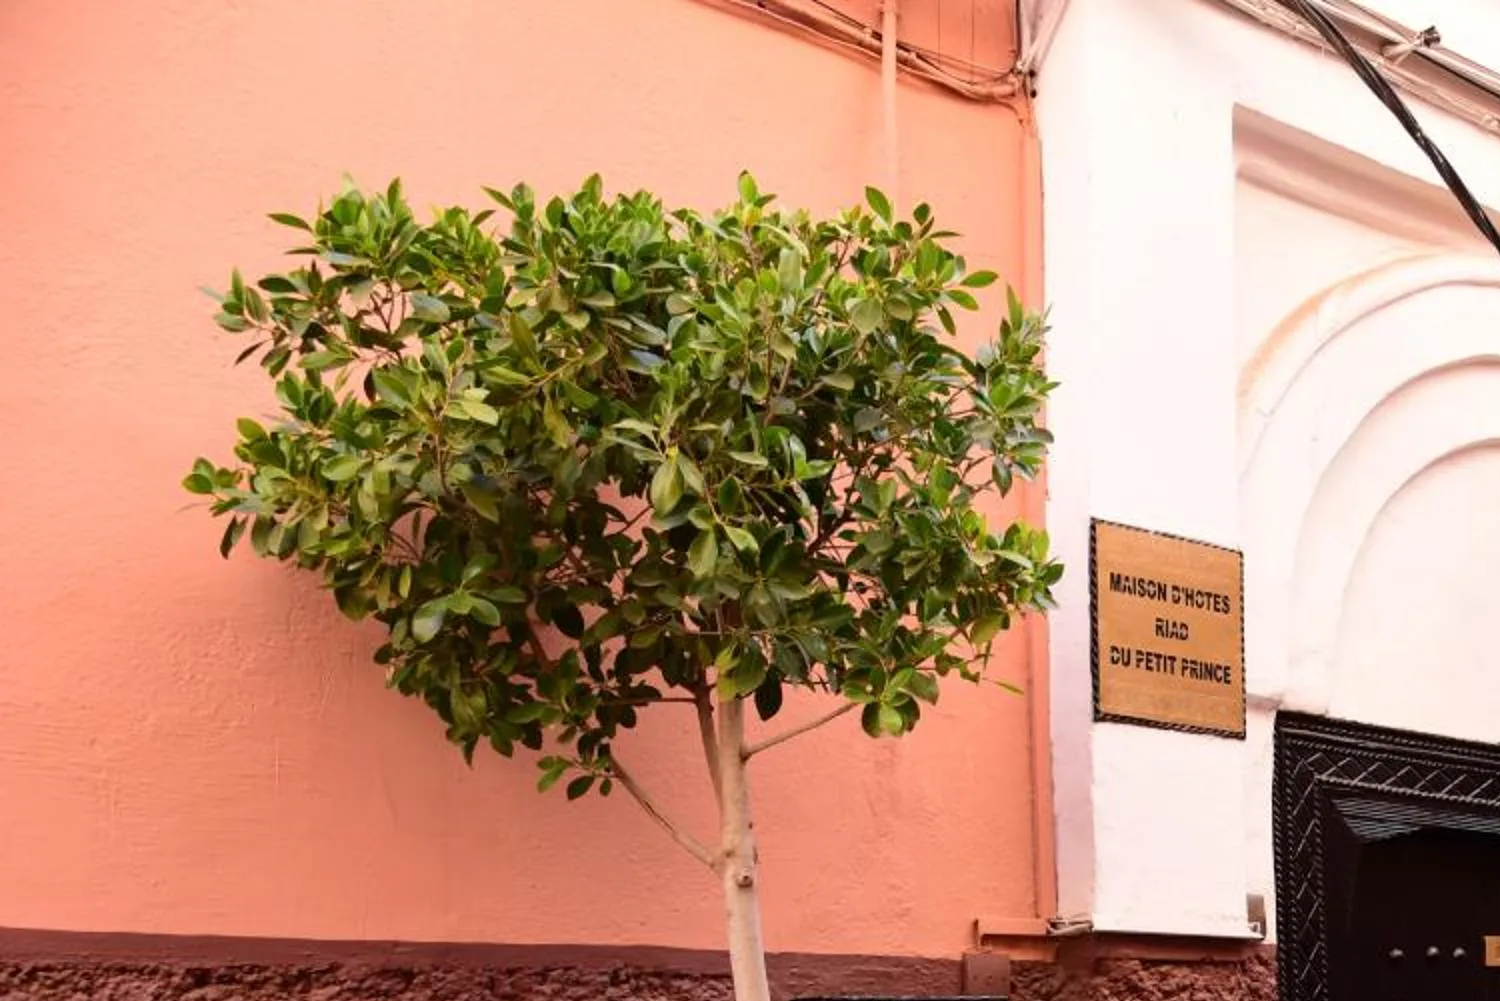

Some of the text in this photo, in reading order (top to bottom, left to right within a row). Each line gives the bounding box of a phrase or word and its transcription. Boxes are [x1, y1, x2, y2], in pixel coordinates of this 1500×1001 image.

[1109, 572, 1168, 602] MAISON
[1155, 617, 1189, 641] RIAD
[1109, 645, 1232, 685] DU PETIT PRINCE
